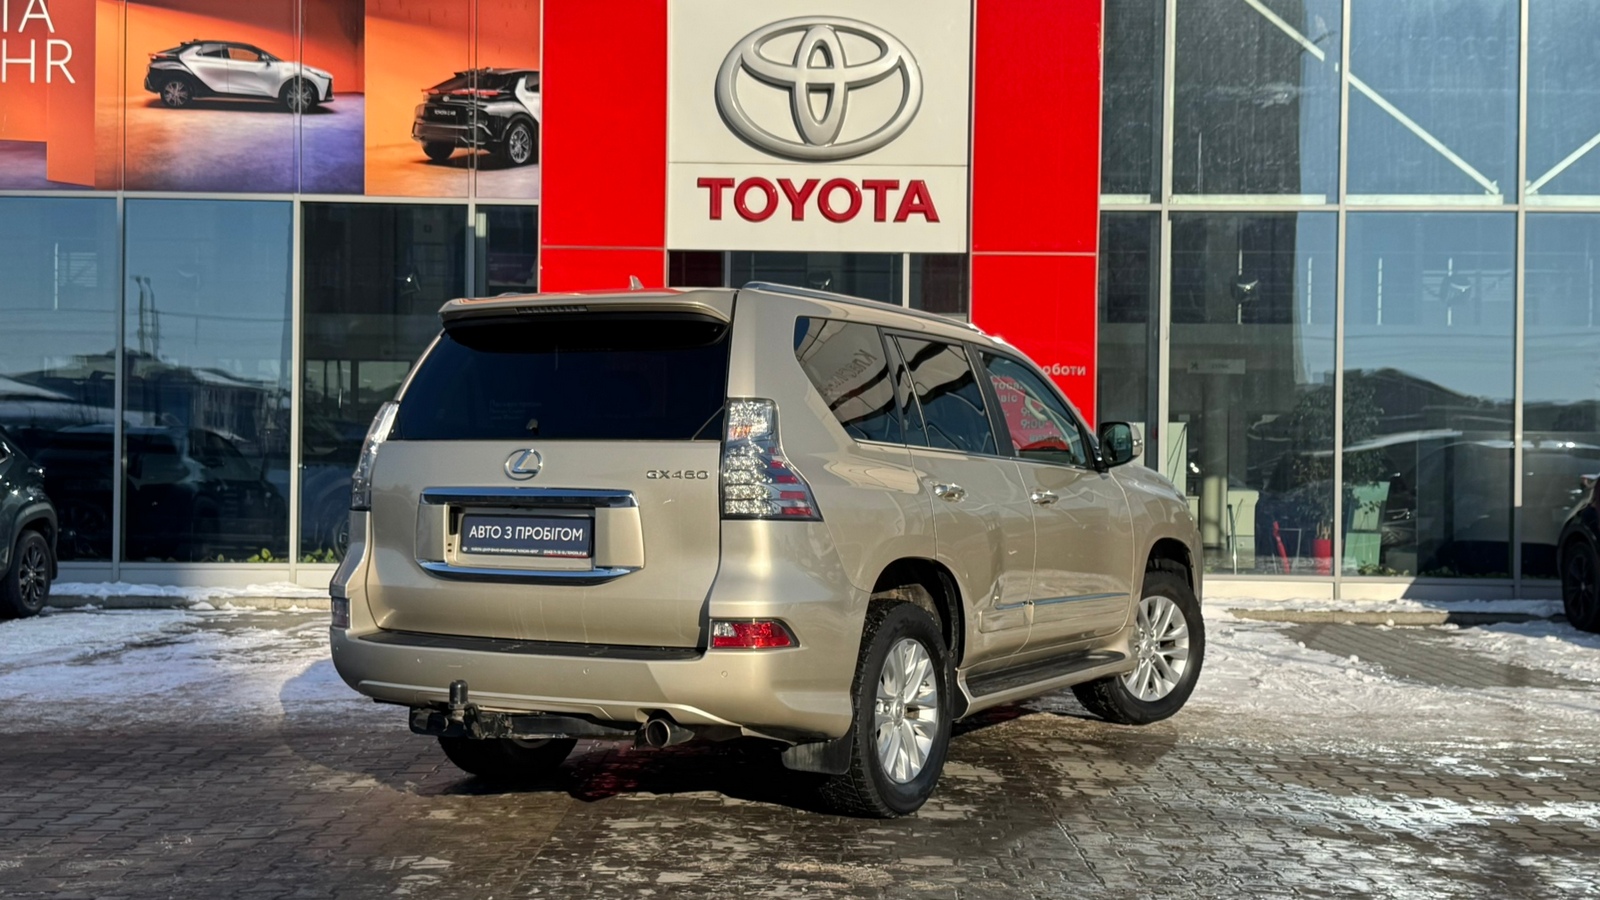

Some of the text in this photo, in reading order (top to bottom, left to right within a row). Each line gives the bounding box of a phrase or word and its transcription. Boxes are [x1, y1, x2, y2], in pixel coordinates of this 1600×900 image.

[697, 176, 940, 223] TOYOTA
[469, 525, 584, 541] АВТО З ПРОБІГОМ
